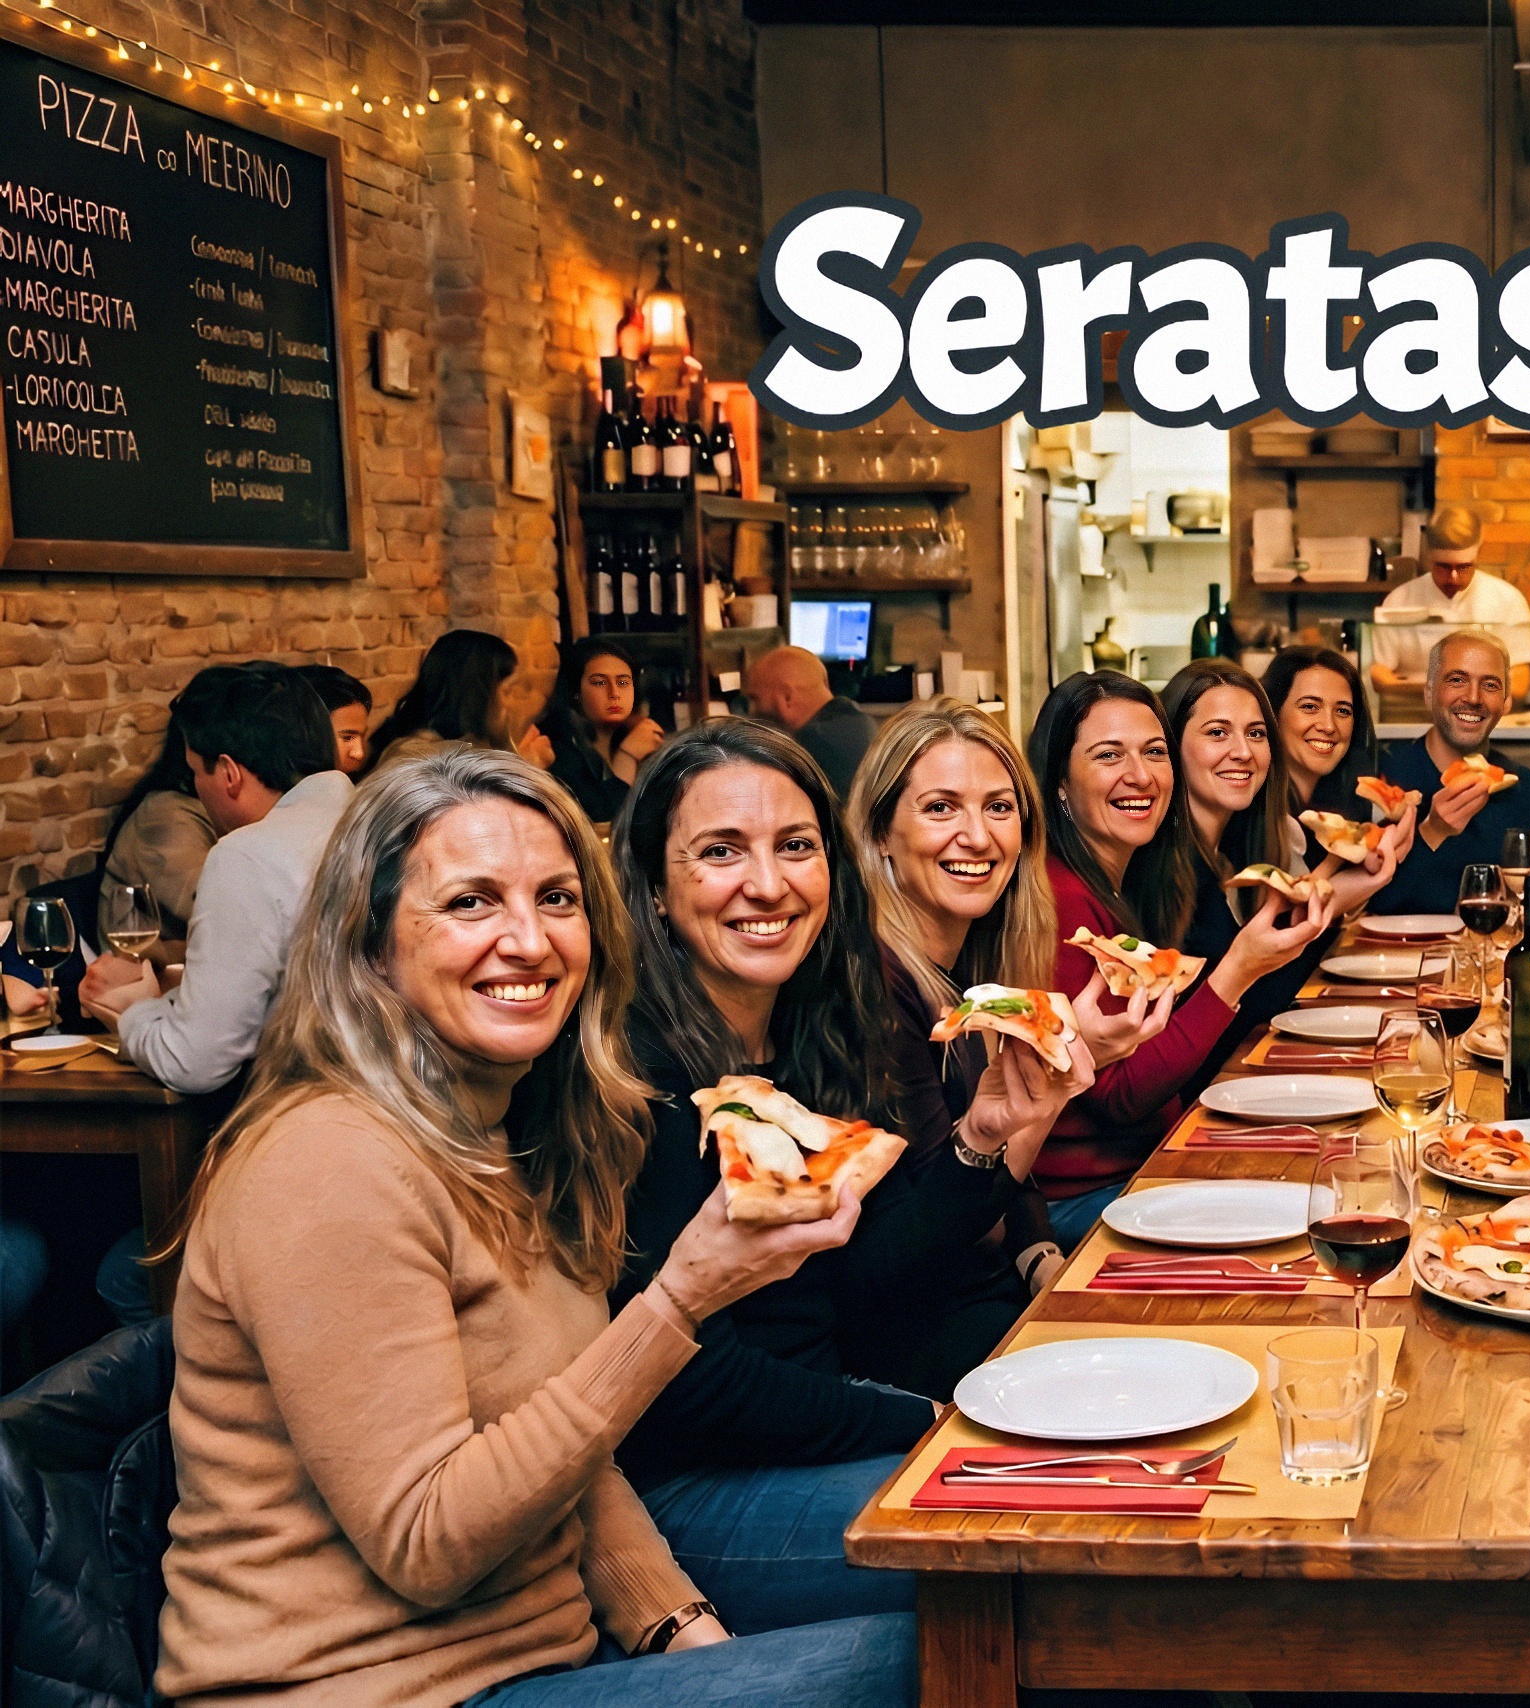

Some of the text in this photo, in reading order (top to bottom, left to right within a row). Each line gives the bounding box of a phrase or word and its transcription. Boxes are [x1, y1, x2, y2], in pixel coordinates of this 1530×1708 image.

[38, 74, 146, 163] PIZZA
[0, 180, 132, 243] MARGHERITA
[0, 225, 96, 279] DIAVOLA
[5, 276, 137, 331] MARGHERITA
[7, 325, 92, 368] CASULA
